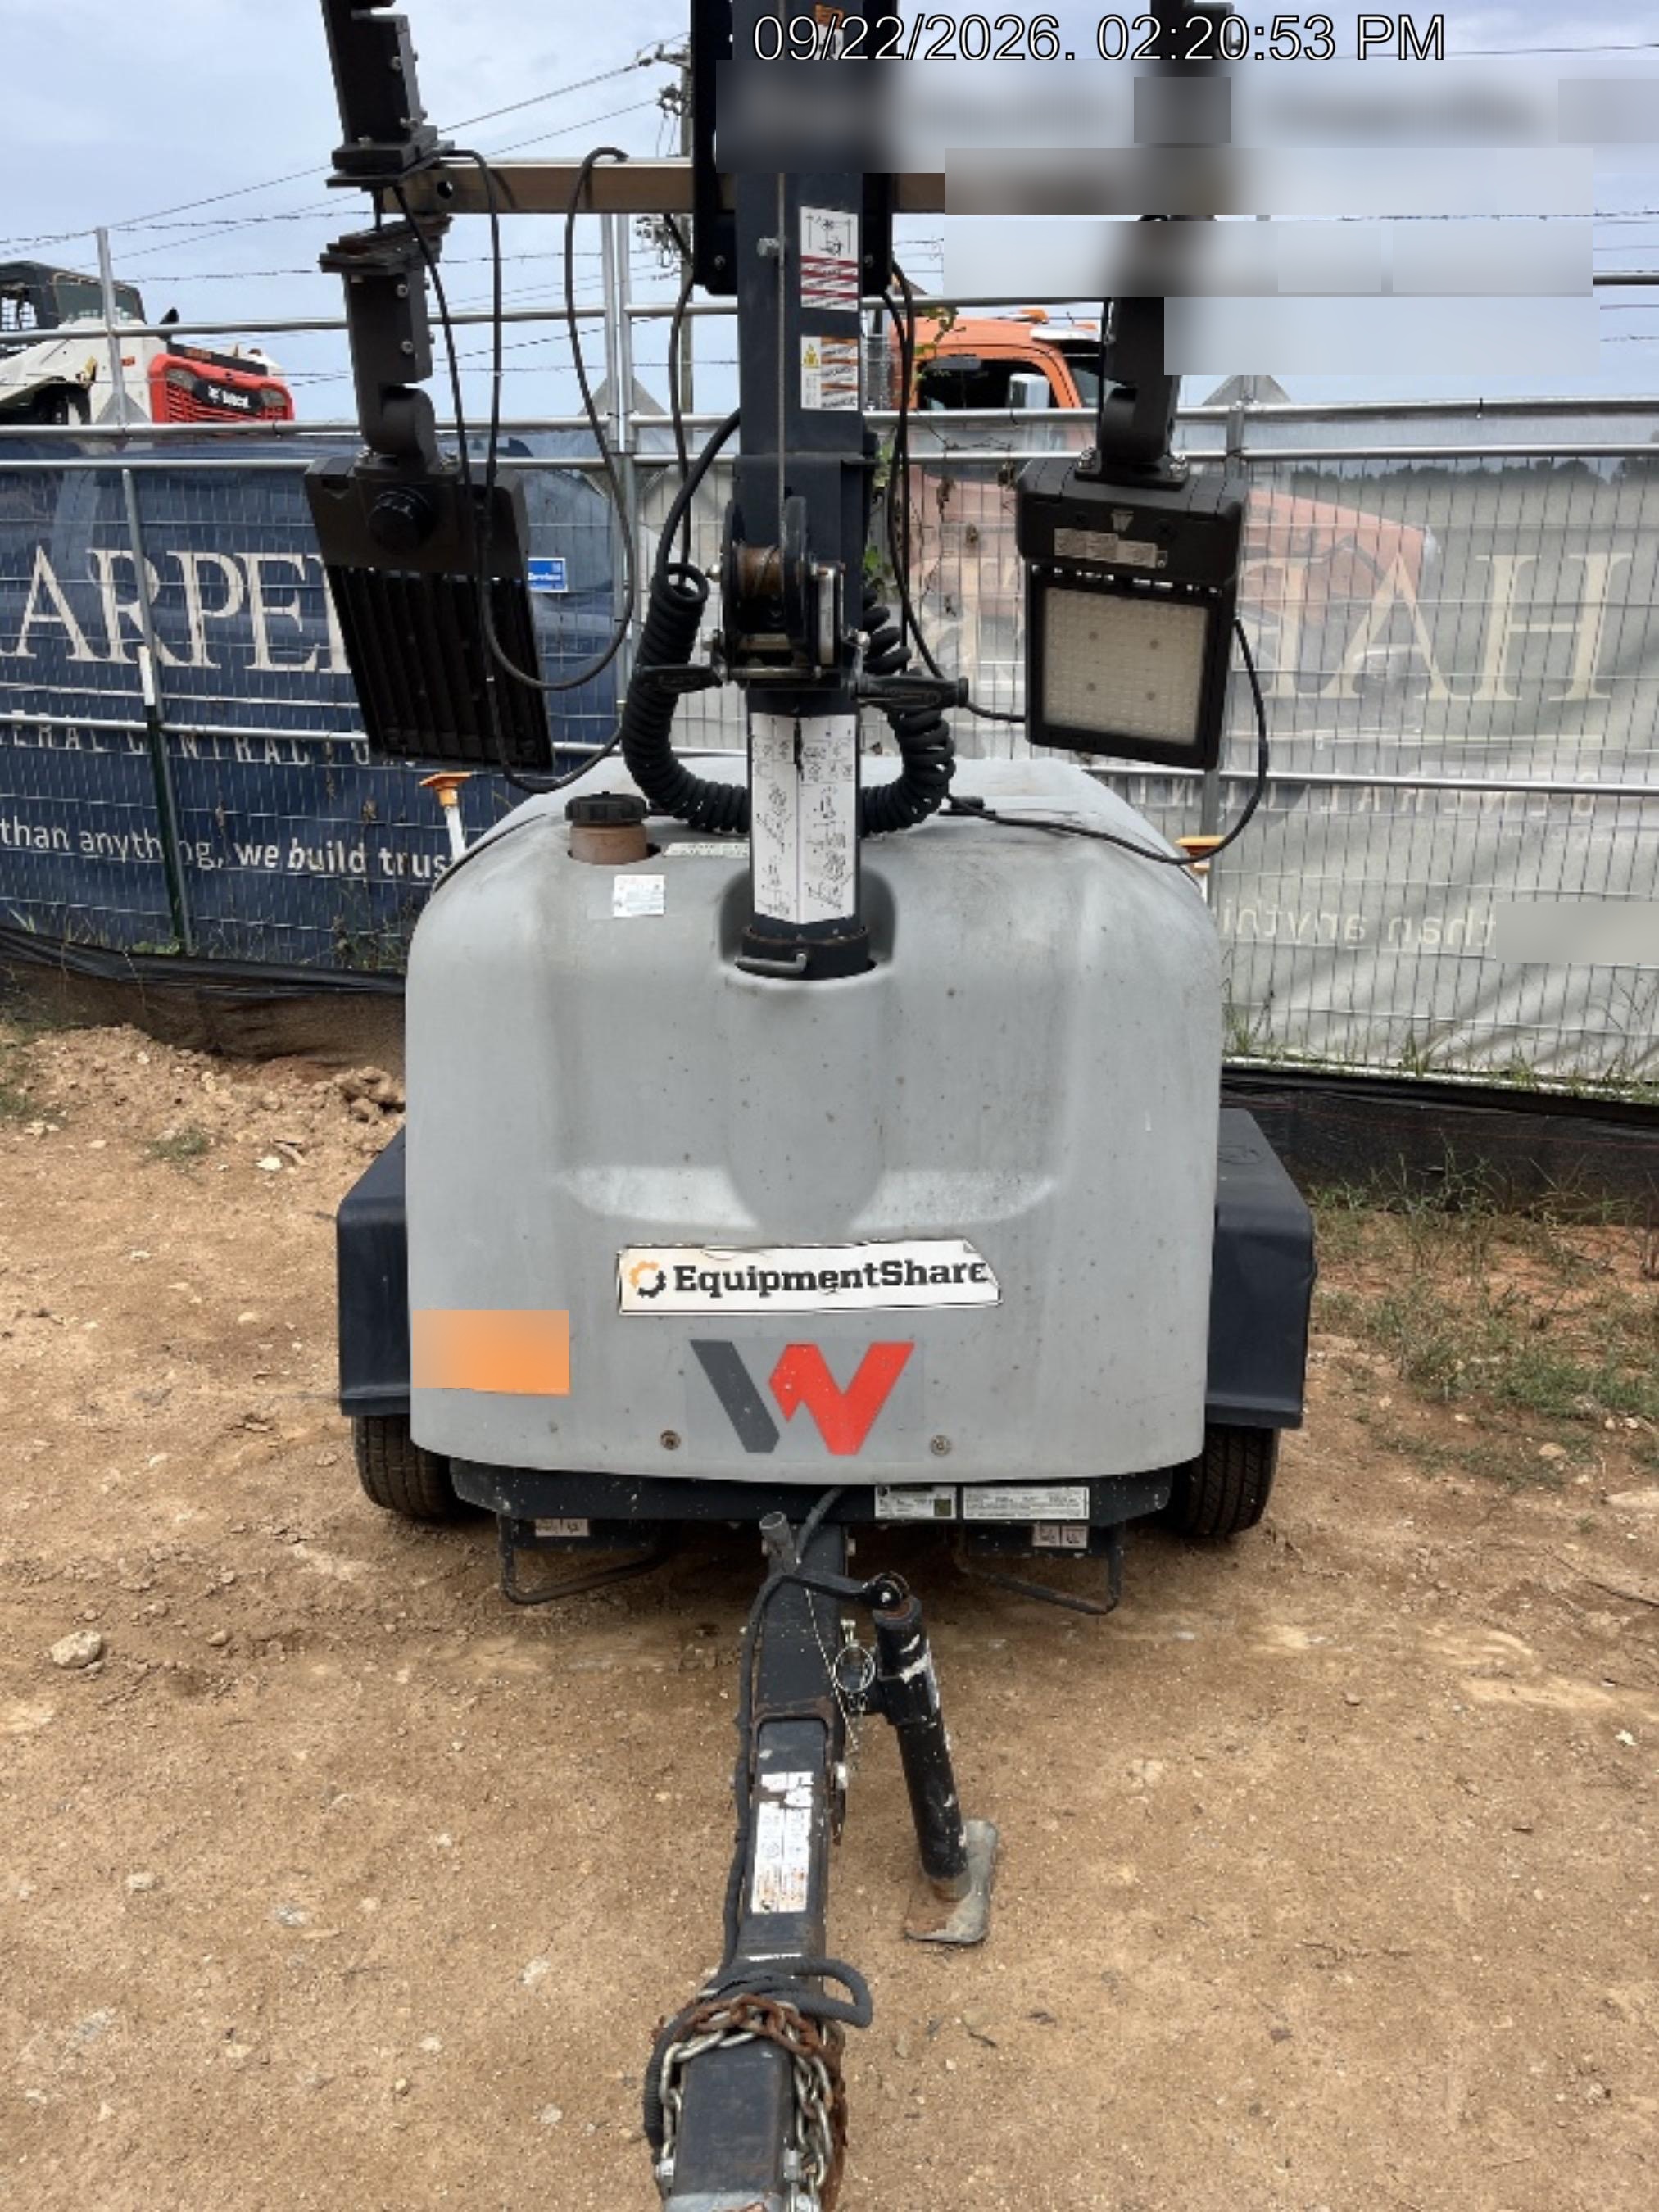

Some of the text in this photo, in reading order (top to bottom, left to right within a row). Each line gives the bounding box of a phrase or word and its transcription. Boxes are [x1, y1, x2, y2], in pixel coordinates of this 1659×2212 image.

[0, 545, 352, 674] ARPE
[0, 815, 456, 880] than anythng, we build trus
[673, 1259, 988, 1299] EquipmentShare
